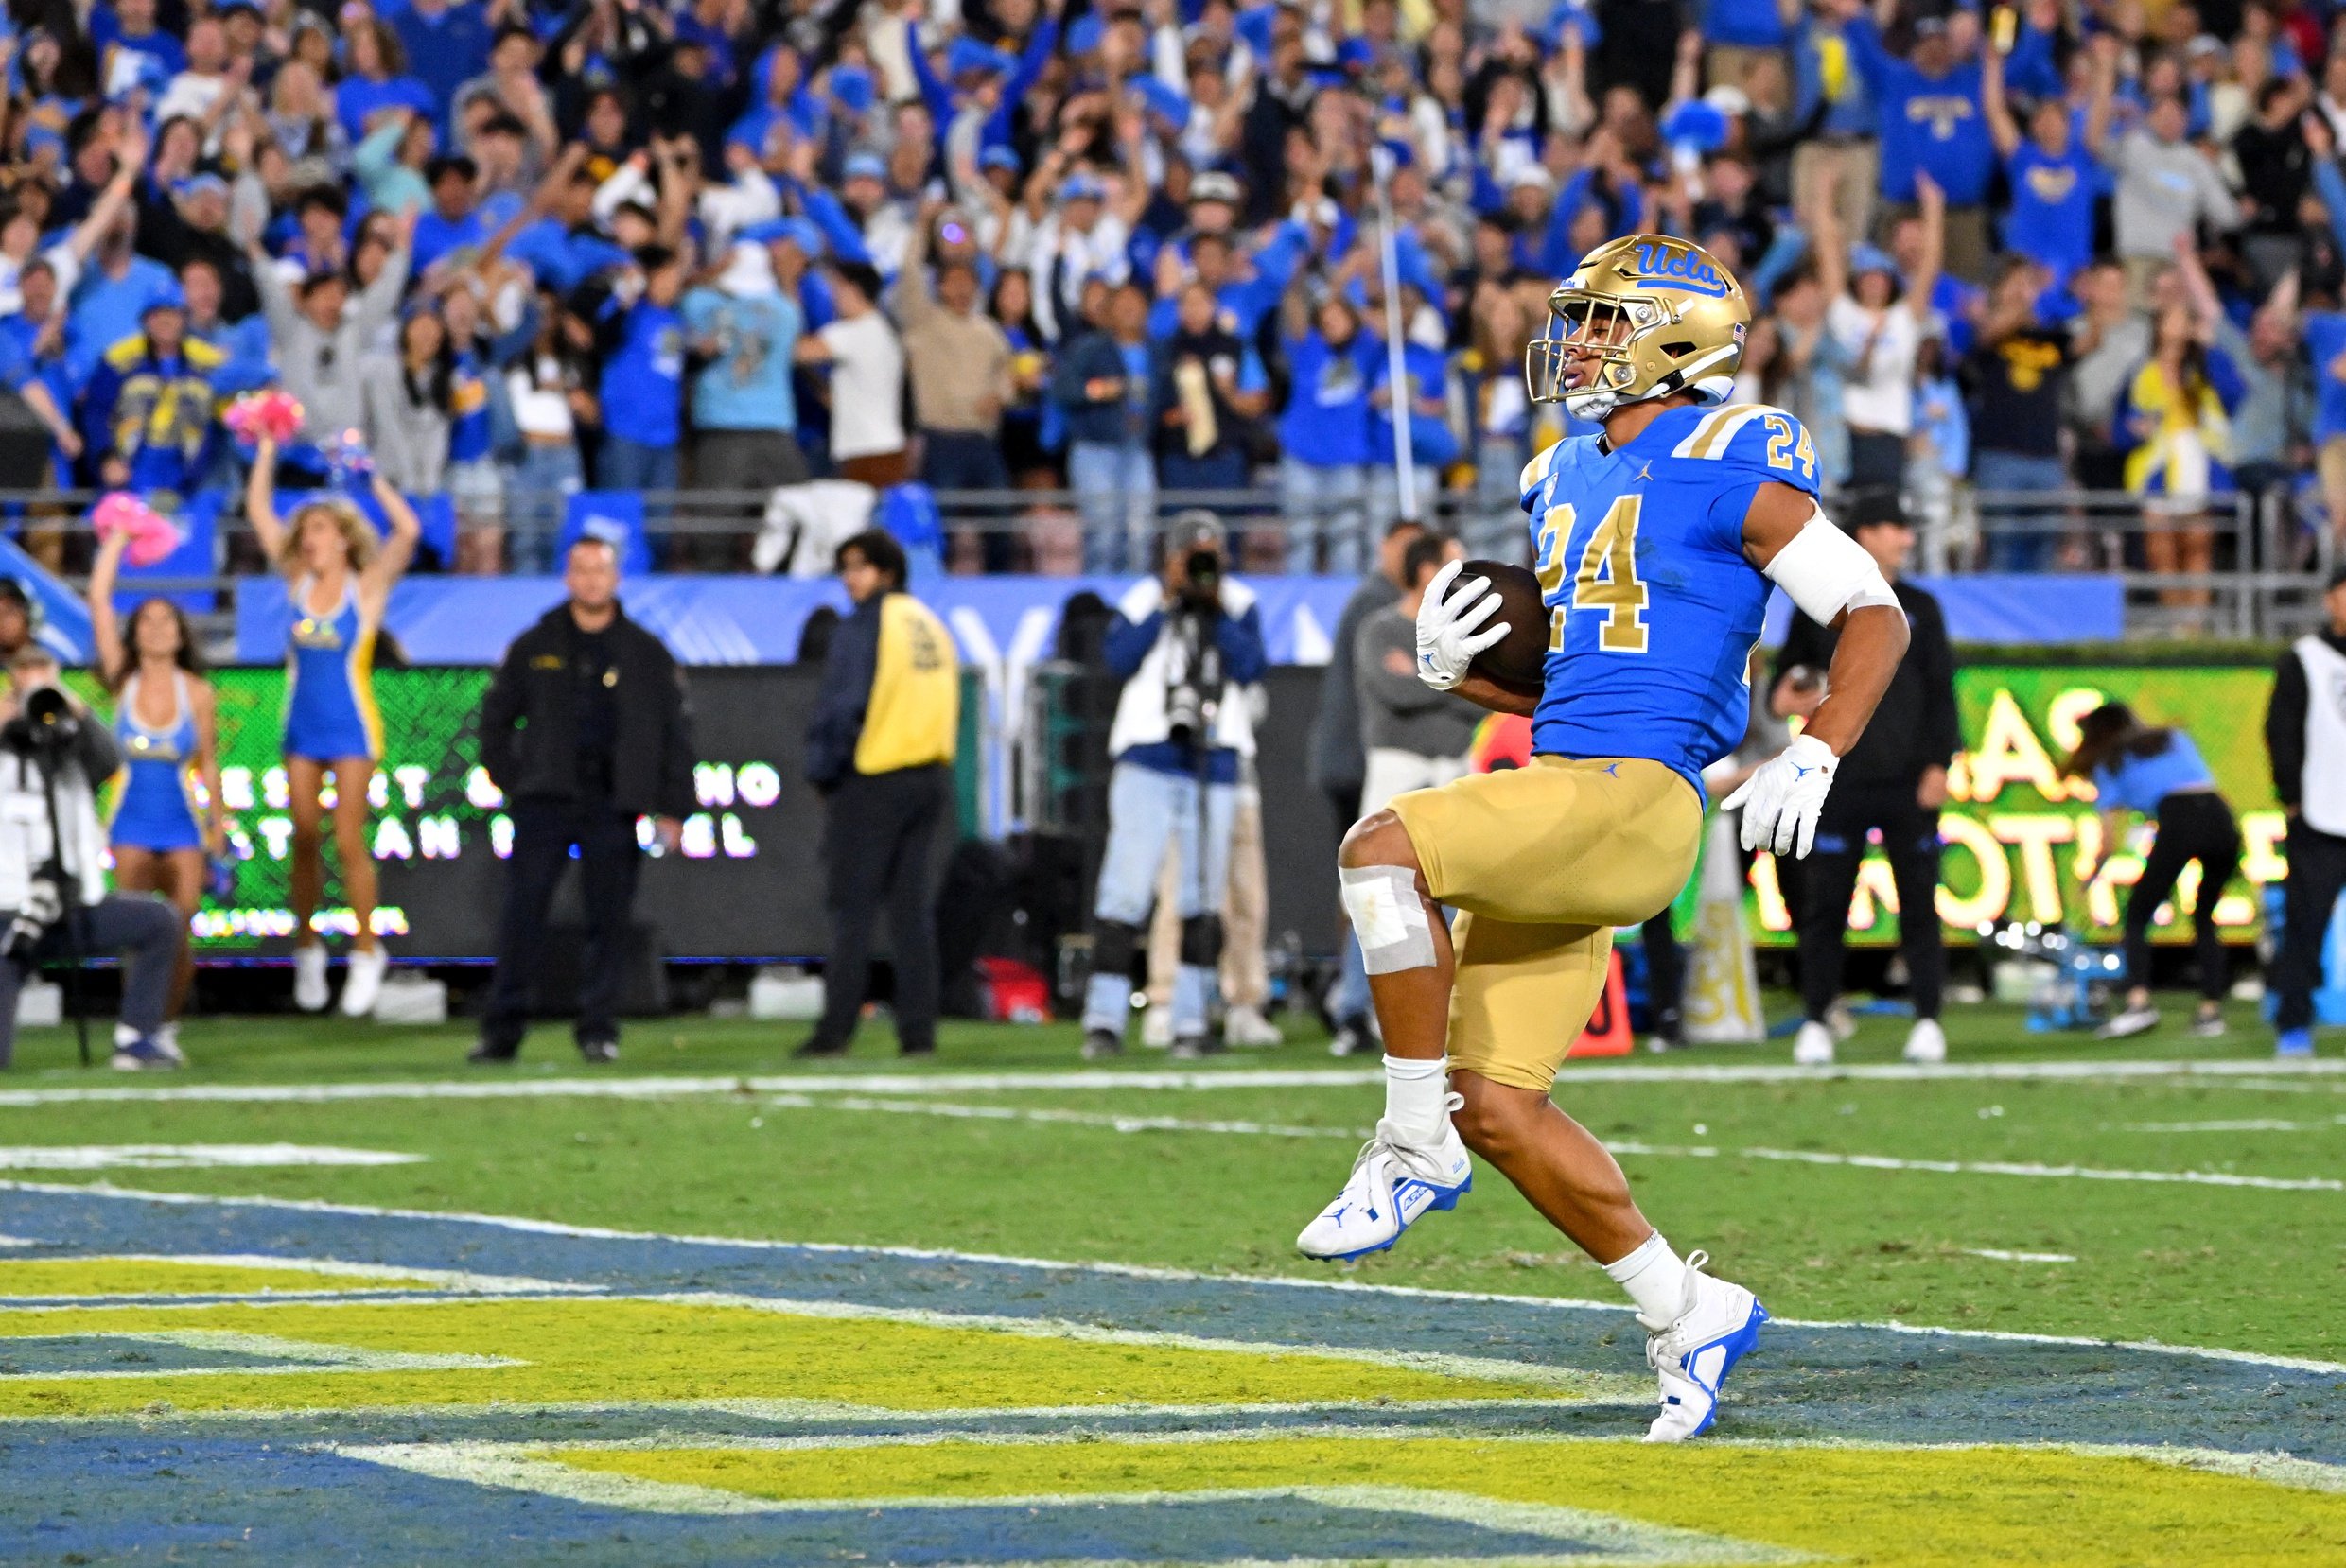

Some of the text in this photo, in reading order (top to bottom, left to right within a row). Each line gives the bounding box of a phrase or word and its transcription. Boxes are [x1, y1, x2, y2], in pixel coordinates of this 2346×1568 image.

[1636, 243, 1726, 296] Ucla
[1763, 414, 1815, 479] 24
[1535, 494, 1650, 653] 24
